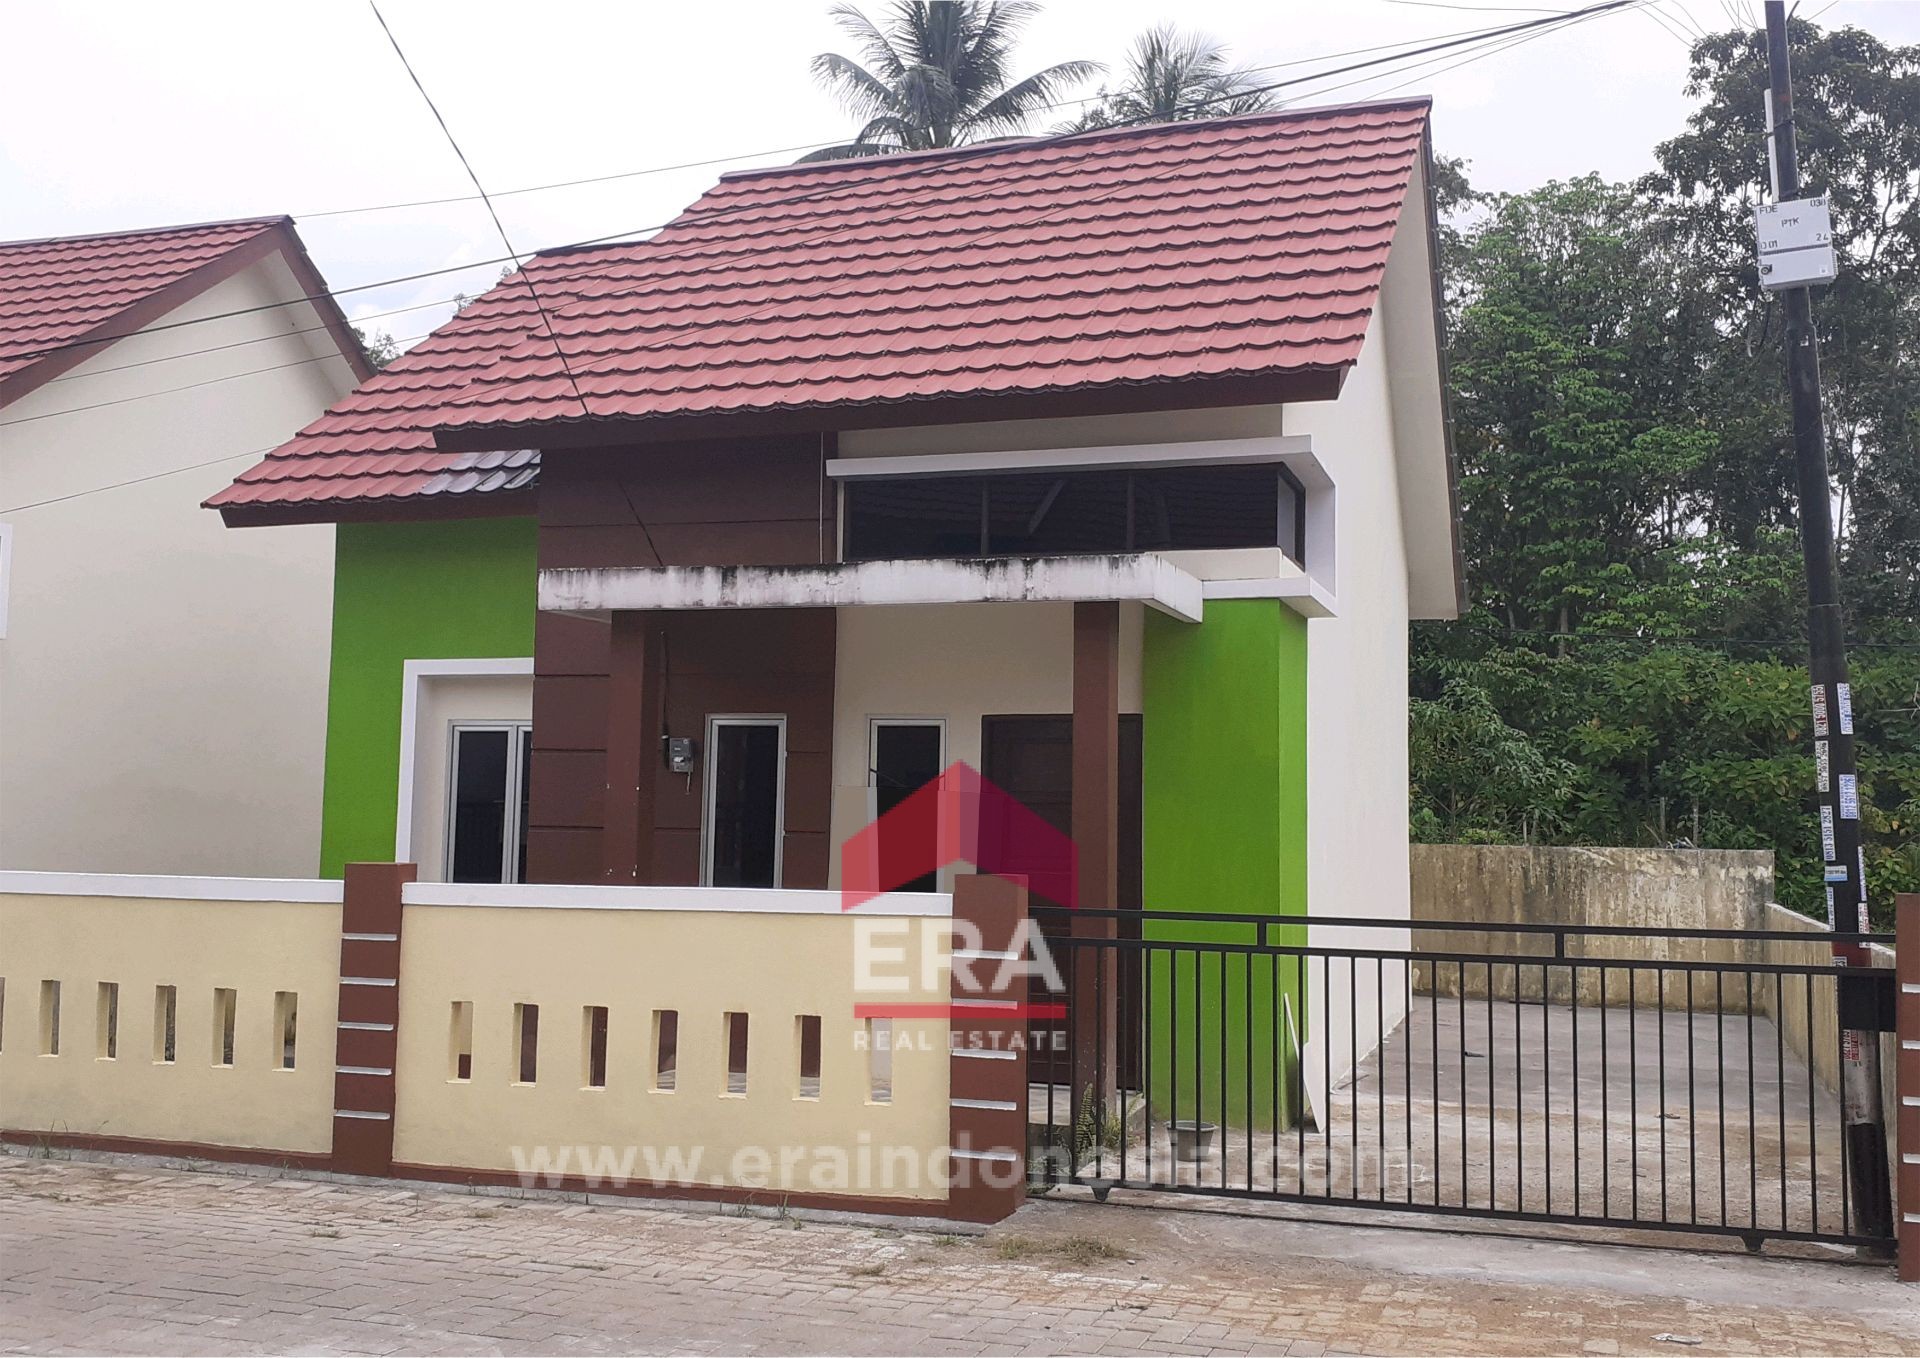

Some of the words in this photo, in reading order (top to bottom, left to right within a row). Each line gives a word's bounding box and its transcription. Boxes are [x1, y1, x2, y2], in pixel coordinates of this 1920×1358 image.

[1781, 217, 1800, 228] PTK
[1821, 807, 1831, 824] 2827
[1823, 826, 1832, 842] 5151
[1824, 843, 1834, 860] 0813
